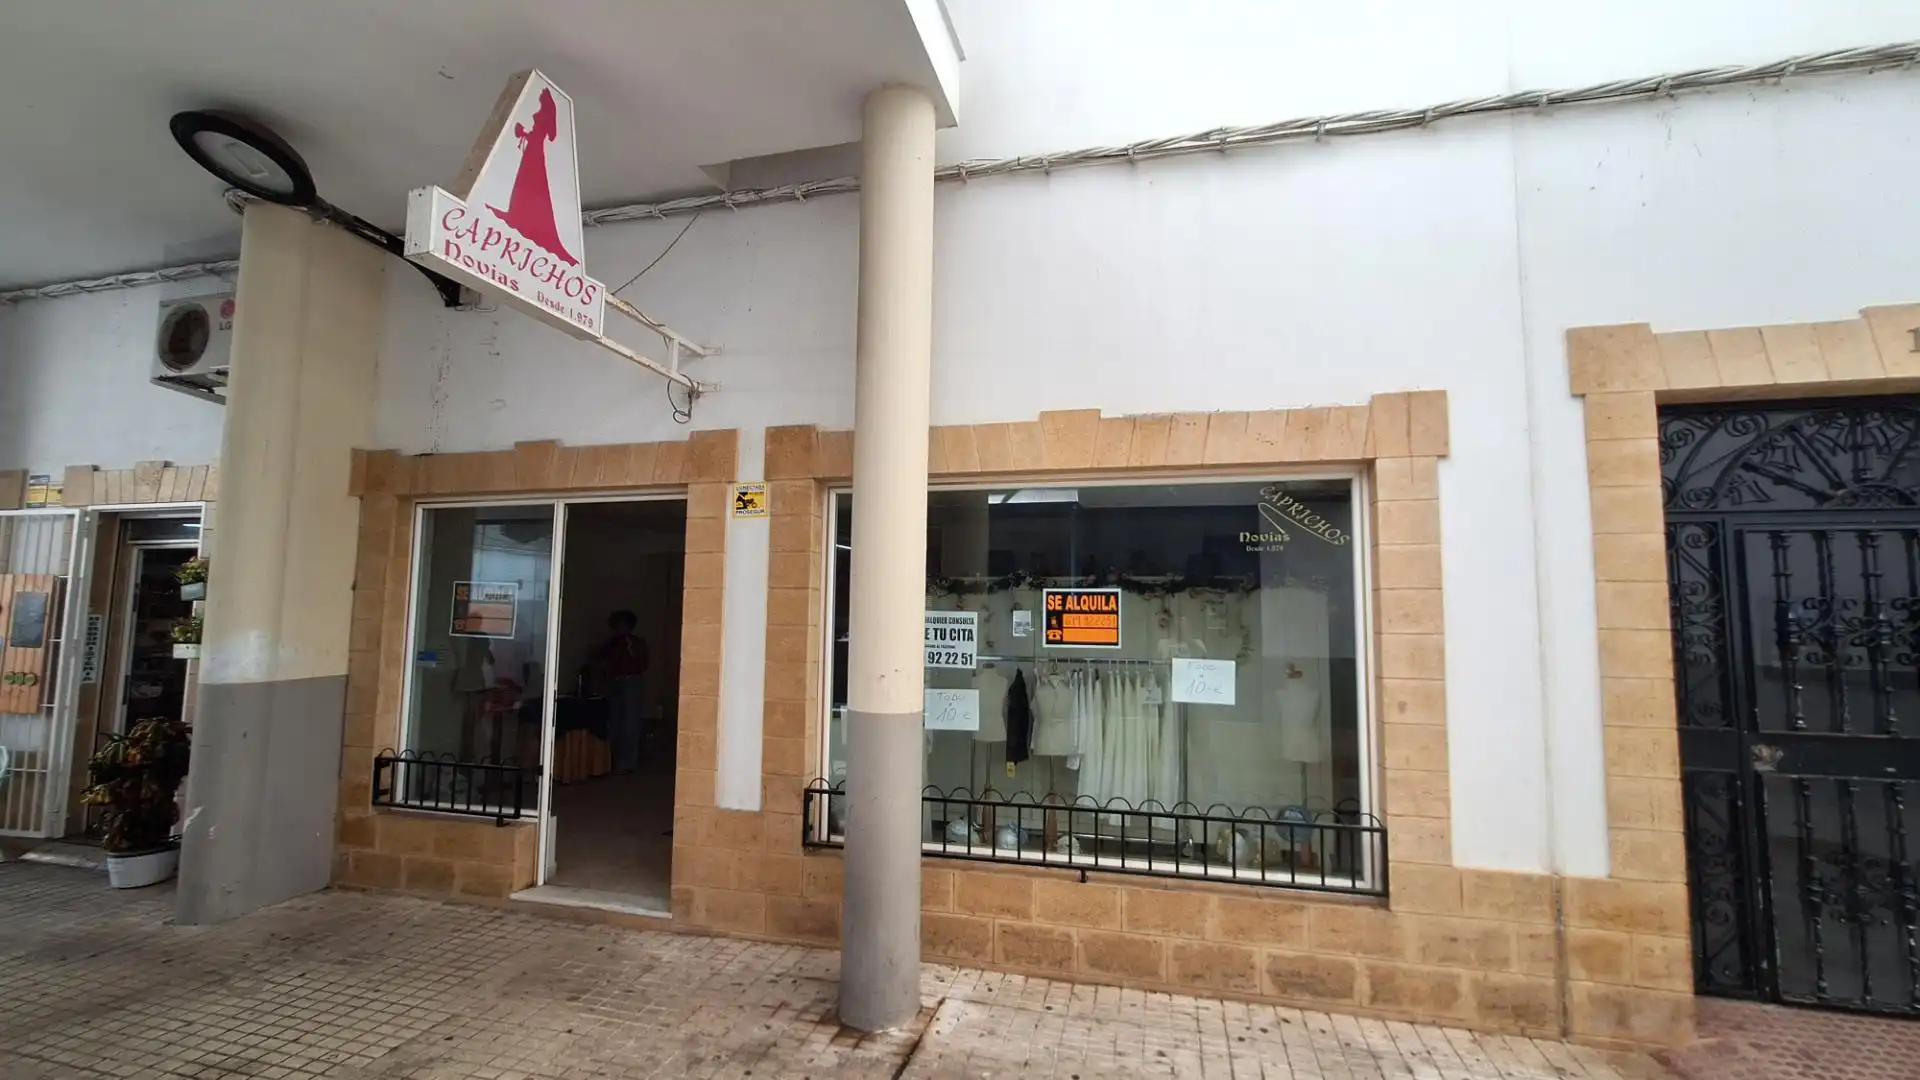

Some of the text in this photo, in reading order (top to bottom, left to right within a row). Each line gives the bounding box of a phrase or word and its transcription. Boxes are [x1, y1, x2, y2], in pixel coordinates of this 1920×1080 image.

[442, 207, 596, 305] CAPRICHOS
[444, 239, 520, 292] Novias
[537, 291, 565, 314] Desde
[218, 321, 232, 331] LG
[1260, 486, 1351, 546] CAPRICHOS
[1239, 531, 1291, 543] Novias
[1047, 595, 1117, 611] SE ALQUILA
[948, 616, 975, 625] CONSULTA
[932, 628, 947, 641] TU
[949, 628, 975, 642] CITA
[927, 651, 973, 666] 92 22 51
